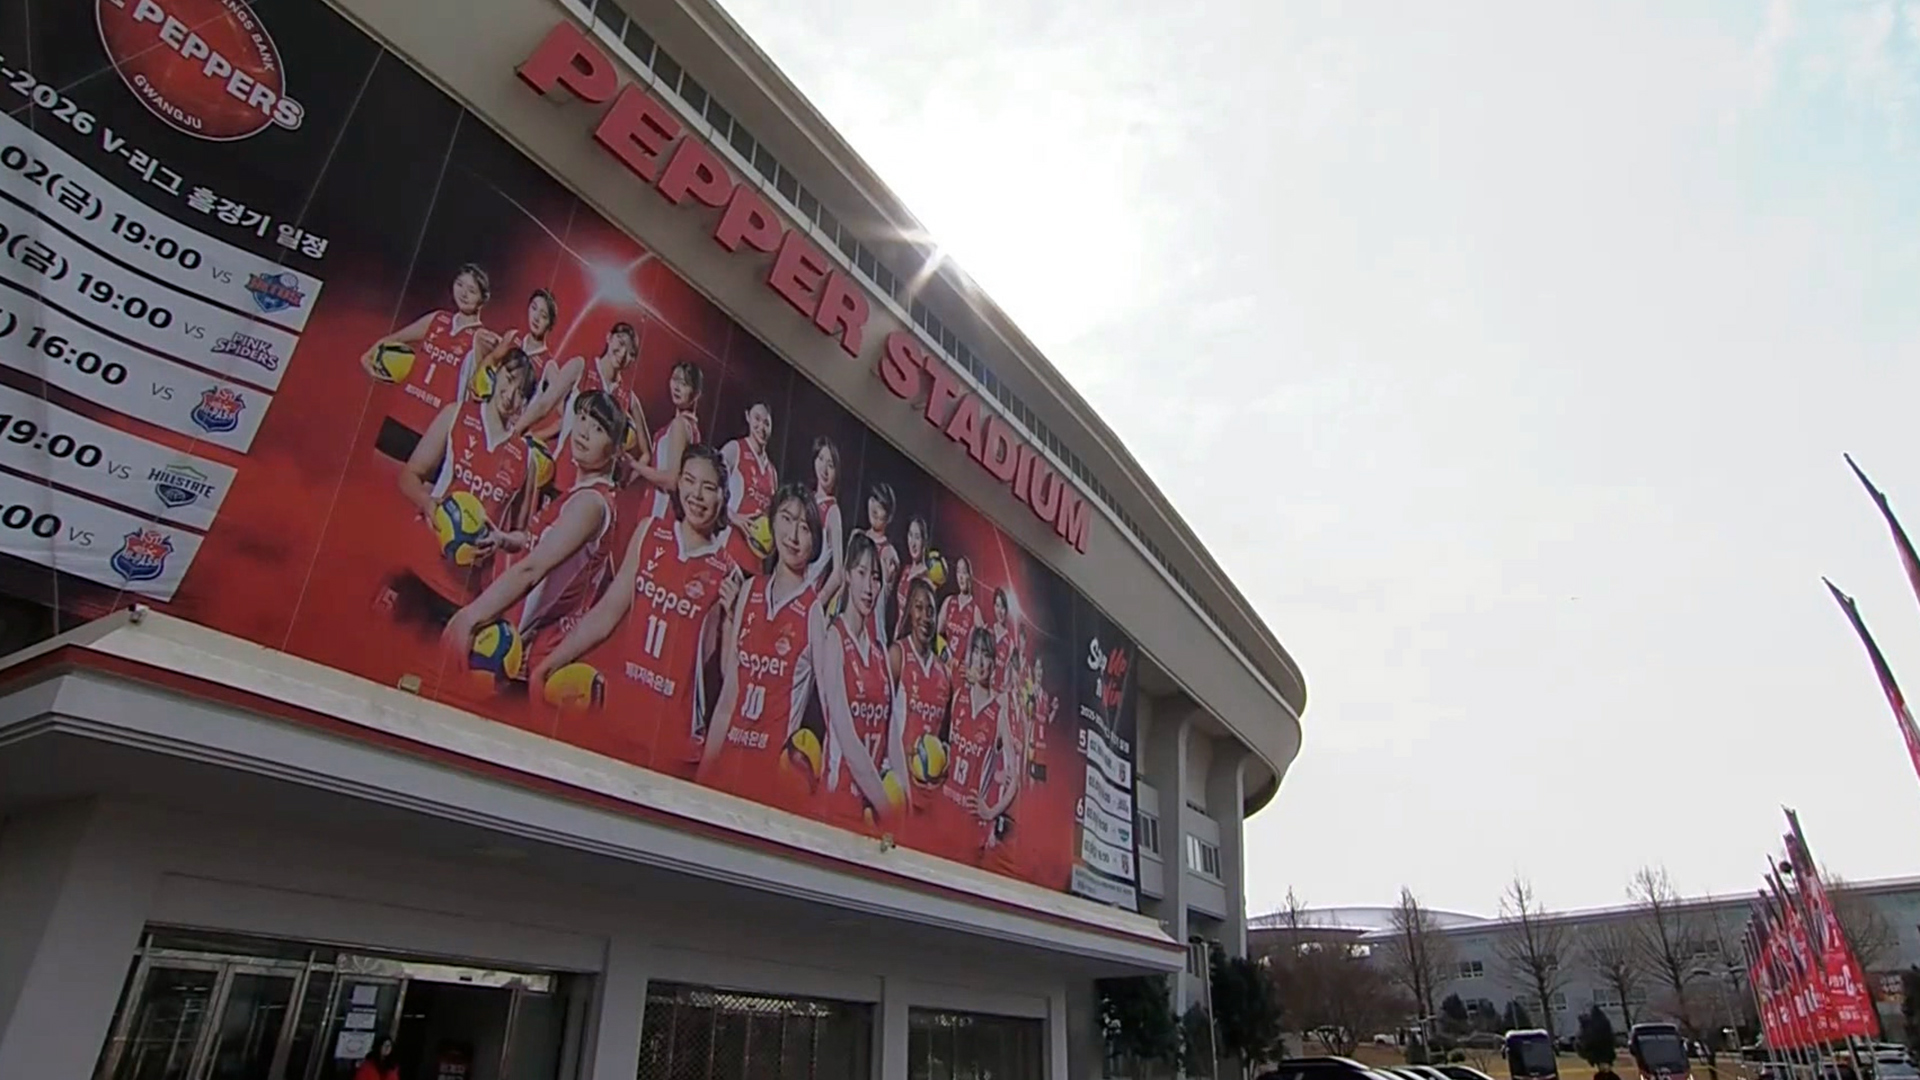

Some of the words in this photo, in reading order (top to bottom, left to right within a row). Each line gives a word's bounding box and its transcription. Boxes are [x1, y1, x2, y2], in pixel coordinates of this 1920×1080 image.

[132, 0, 300, 126] PEPPERS
[251, 33, 275, 71] BANK
[133, 74, 203, 130] GWANGJU
[0, 54, 96, 135] -2026
[102, 127, 183, 196] V-리그
[187, 186, 271, 237] 홈경기
[276, 223, 329, 260] 일정
[1, 146, 103, 221] 02(금)
[110, 212, 202, 270] 19:00
[77, 272, 172, 329] 19:00
[517, 20, 870, 358] PEPPER
[877, 331, 1091, 555] STADIUM
[27, 326, 128, 385] 16:00
[210, 337, 279, 371] SPIDERS
[232, 331, 272, 354] PINK
[0, 414, 103, 468] 19:00
[148, 468, 215, 498] HILLSTATE
[645, 613, 668, 660] 11
[741, 682, 766, 722] 10
[1079, 729, 1087, 748] 5
[953, 755, 969, 786] 13
[1076, 797, 1085, 820] 6
